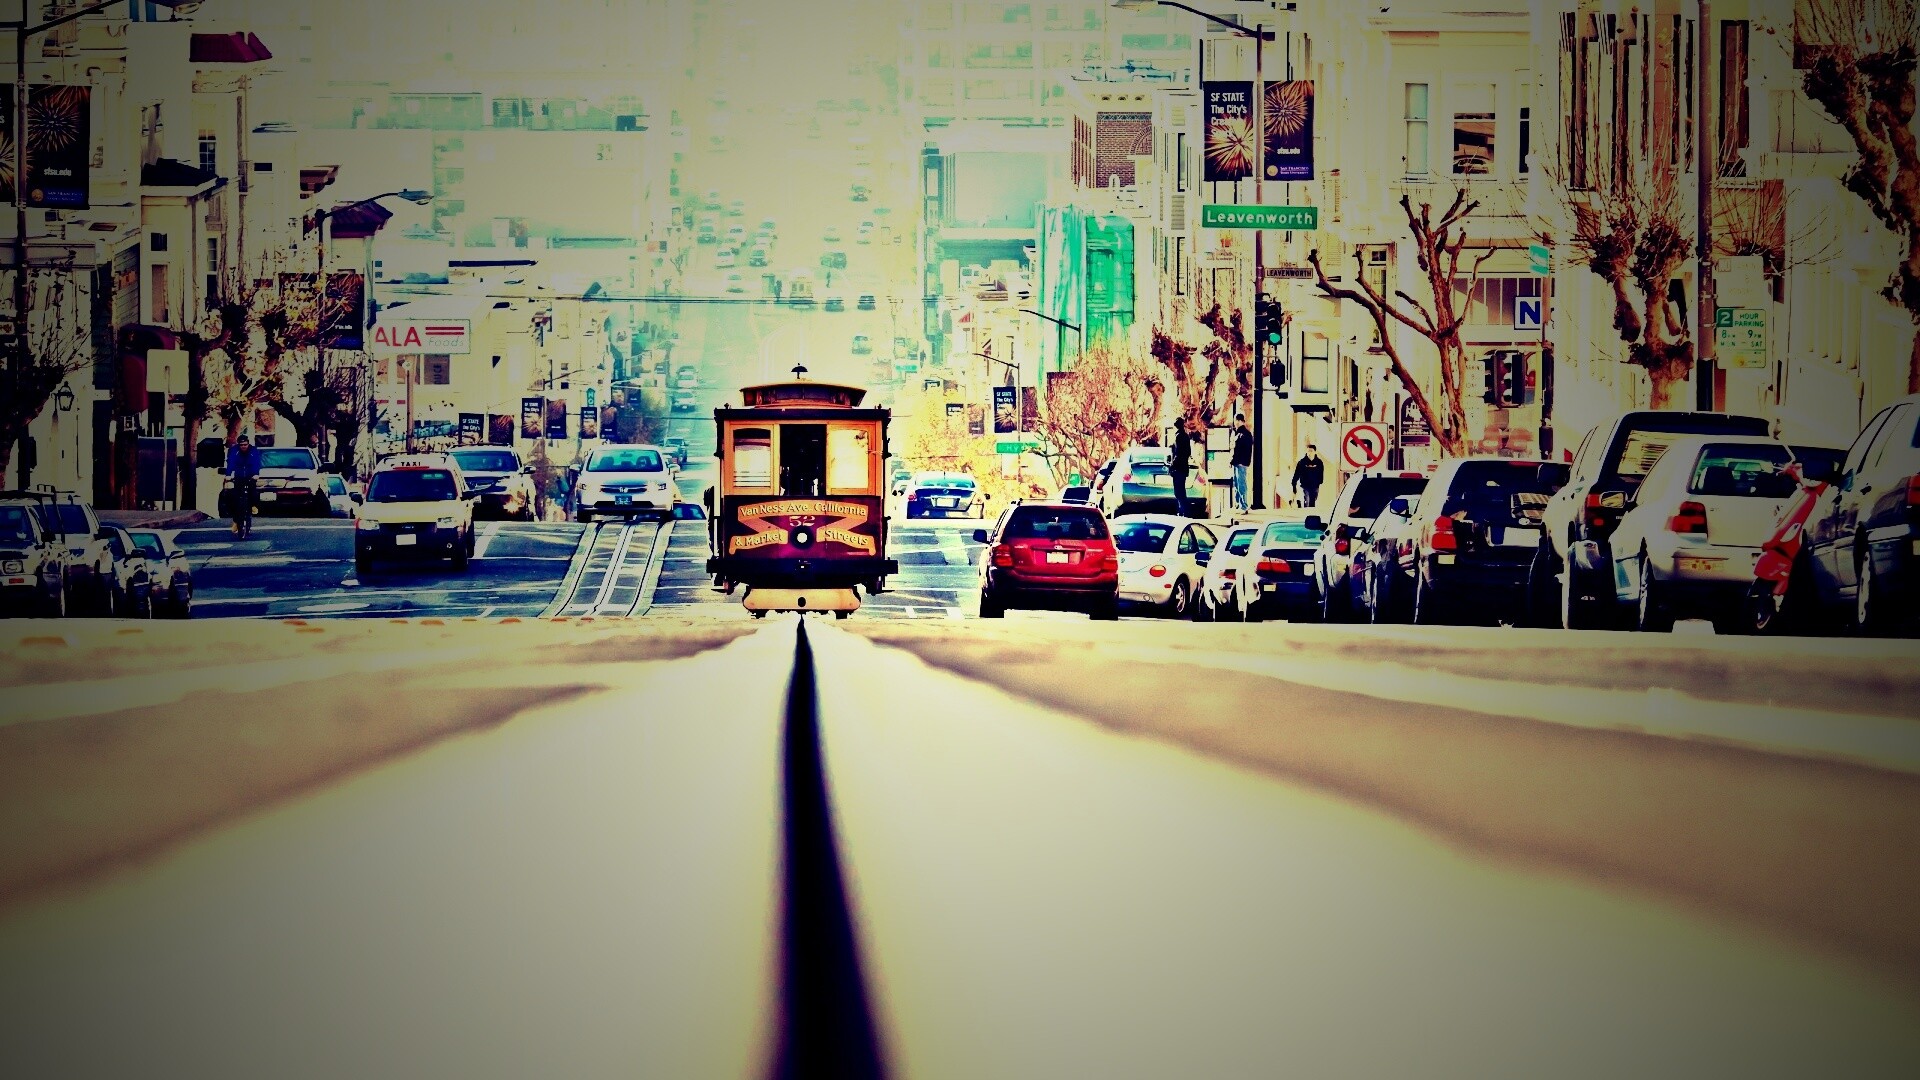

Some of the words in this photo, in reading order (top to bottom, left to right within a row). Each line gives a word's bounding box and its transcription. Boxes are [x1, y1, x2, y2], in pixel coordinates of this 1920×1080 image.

[1211, 93, 1220, 102] SF
[1222, 93, 1245, 102] STATE
[1211, 105, 1224, 114] The
[1227, 104, 1249, 116] City's
[1207, 210, 1313, 225] Leavenworth
[1266, 269, 1312, 277] LEAVENWORTH
[1720, 311, 1731, 325] 2
[375, 326, 422, 347] ALA
[741, 506, 758, 517] Van
[759, 503, 784, 515] Ness
[814, 502, 868, 517] California
[789, 515, 816, 527] 52
[734, 536, 743, 547] &
[744, 532, 784, 546] Market
[825, 529, 870, 546] Streets
